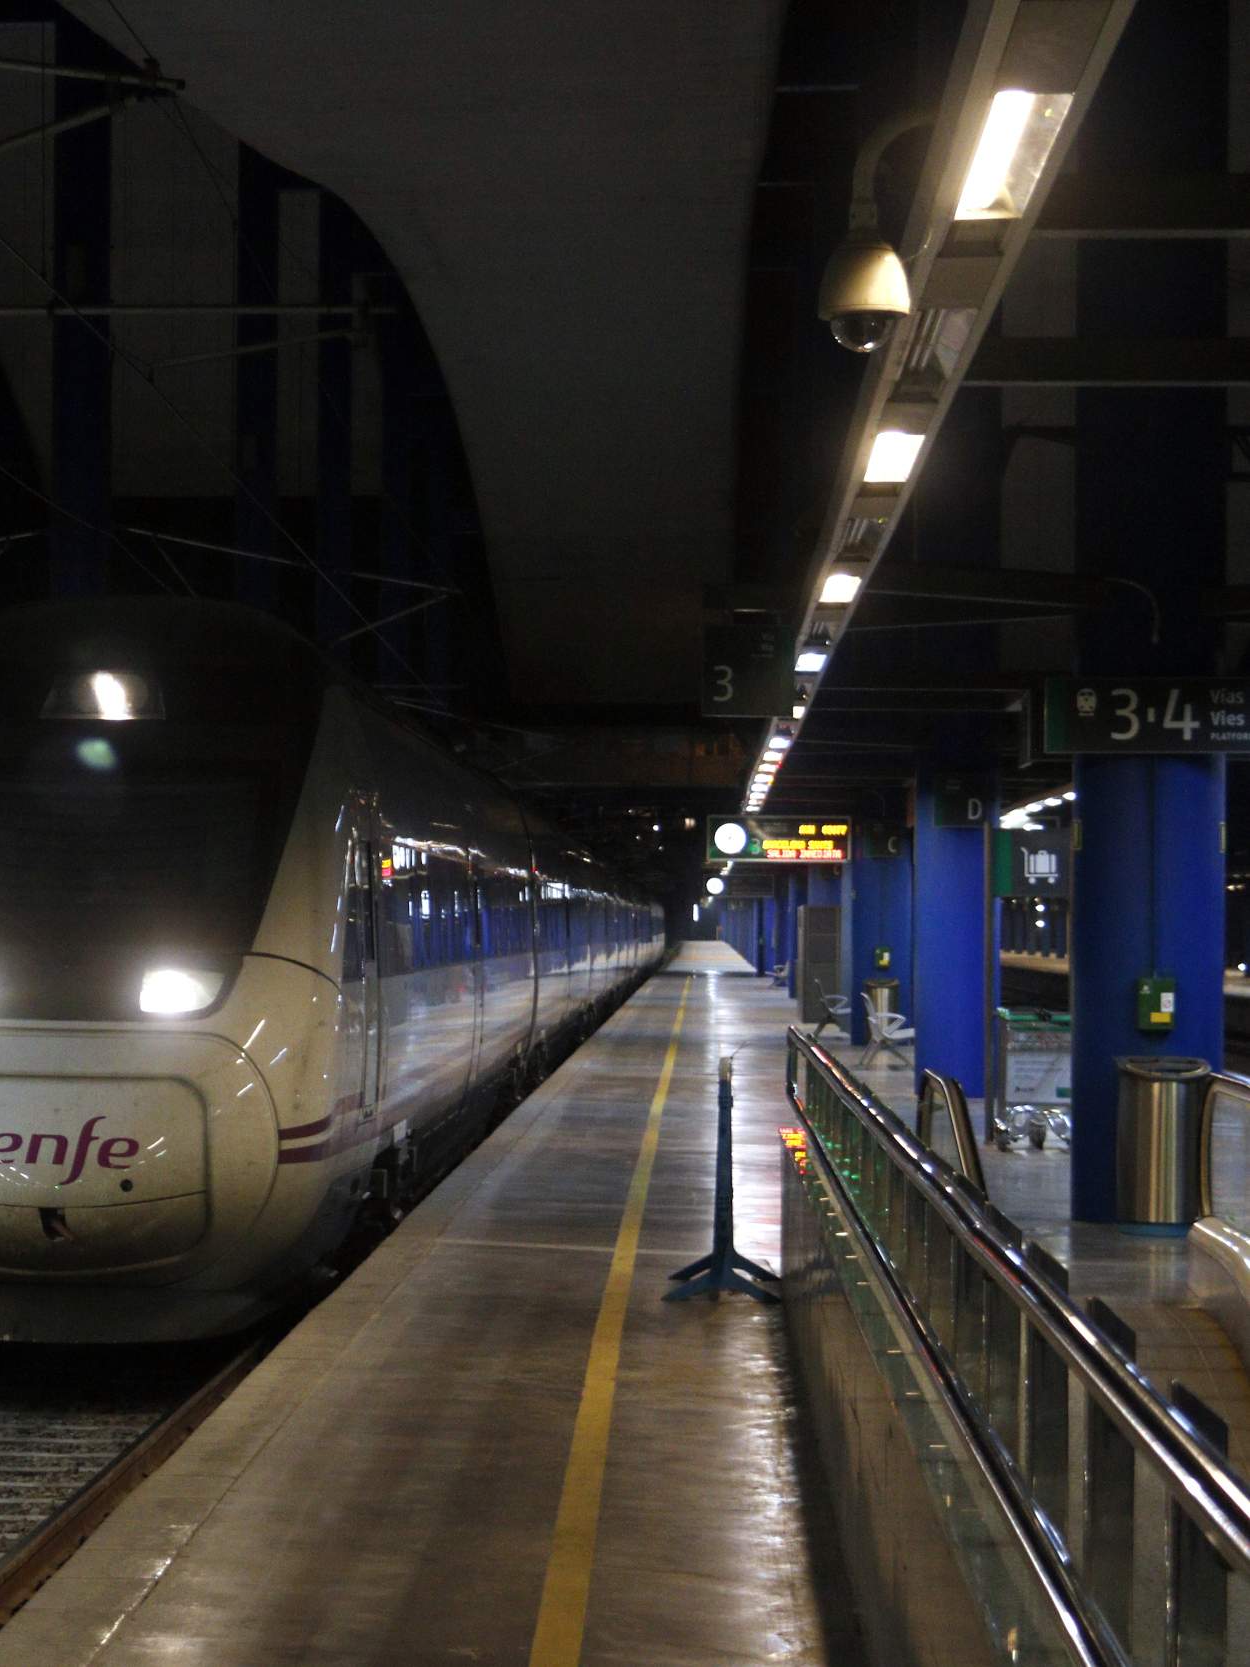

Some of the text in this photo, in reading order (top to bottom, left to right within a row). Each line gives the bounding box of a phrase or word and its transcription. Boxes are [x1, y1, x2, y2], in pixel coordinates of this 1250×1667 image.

[713, 665, 733, 701] 3
[1210, 710, 1245, 726] Vies
[967, 798, 982, 820] D
[887, 836, 898, 853] C
